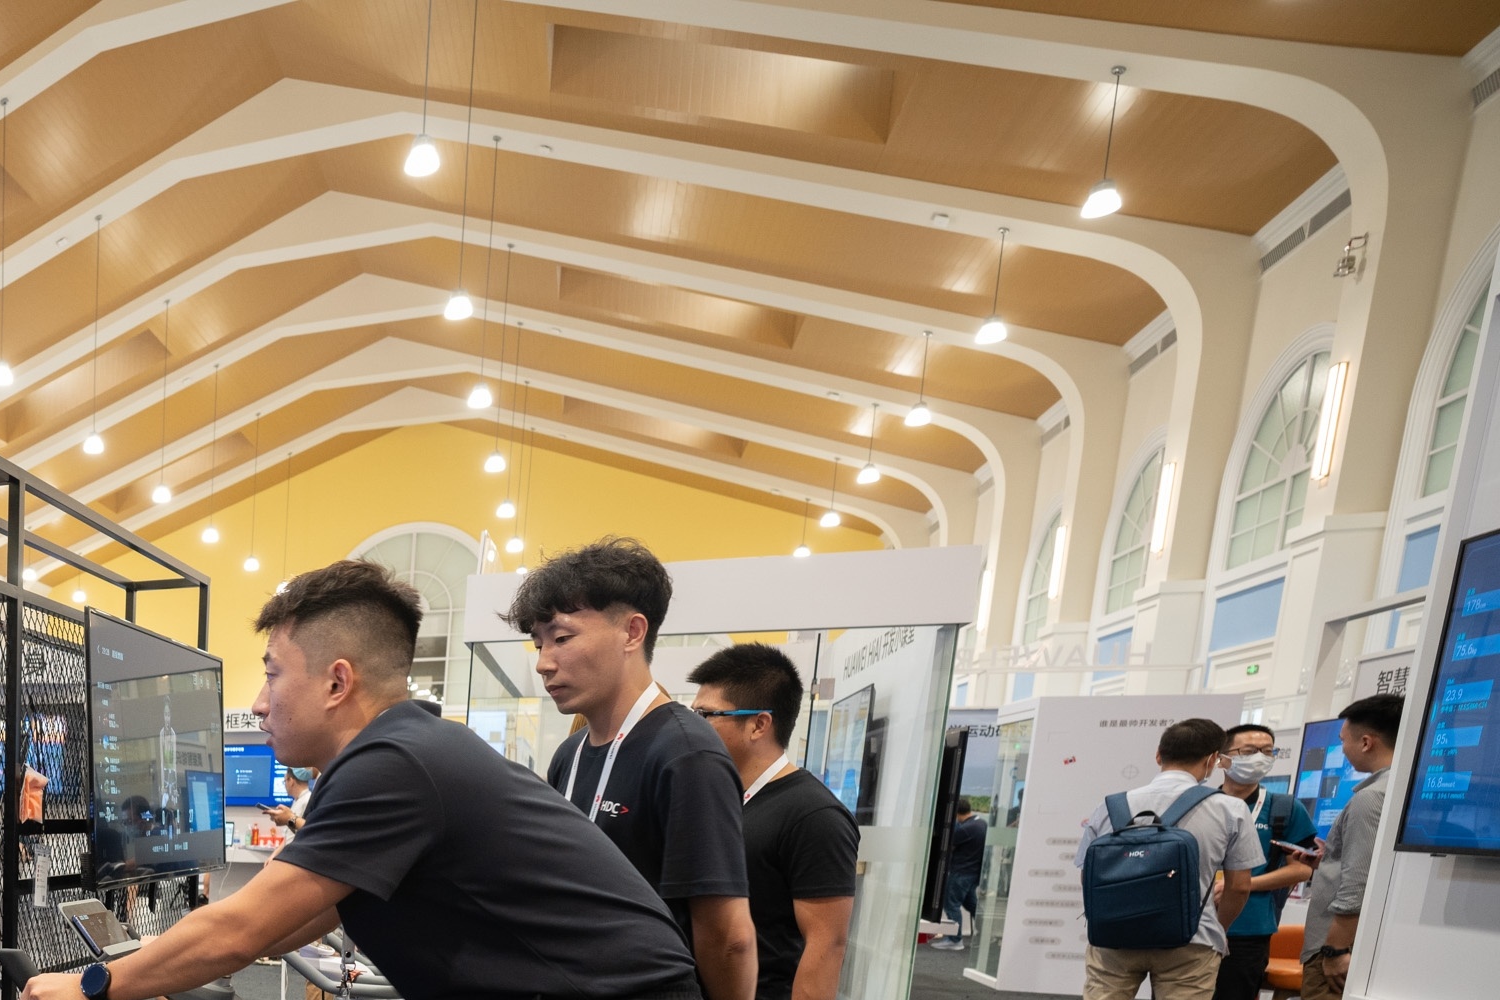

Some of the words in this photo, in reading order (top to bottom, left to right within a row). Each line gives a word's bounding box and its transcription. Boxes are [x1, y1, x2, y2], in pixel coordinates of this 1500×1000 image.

[1445, 688, 1463, 703] 23.9
[225, 713, 264, 729] 框架
[600, 800, 620, 815] HDC
[1129, 850, 1145, 858] HDC
